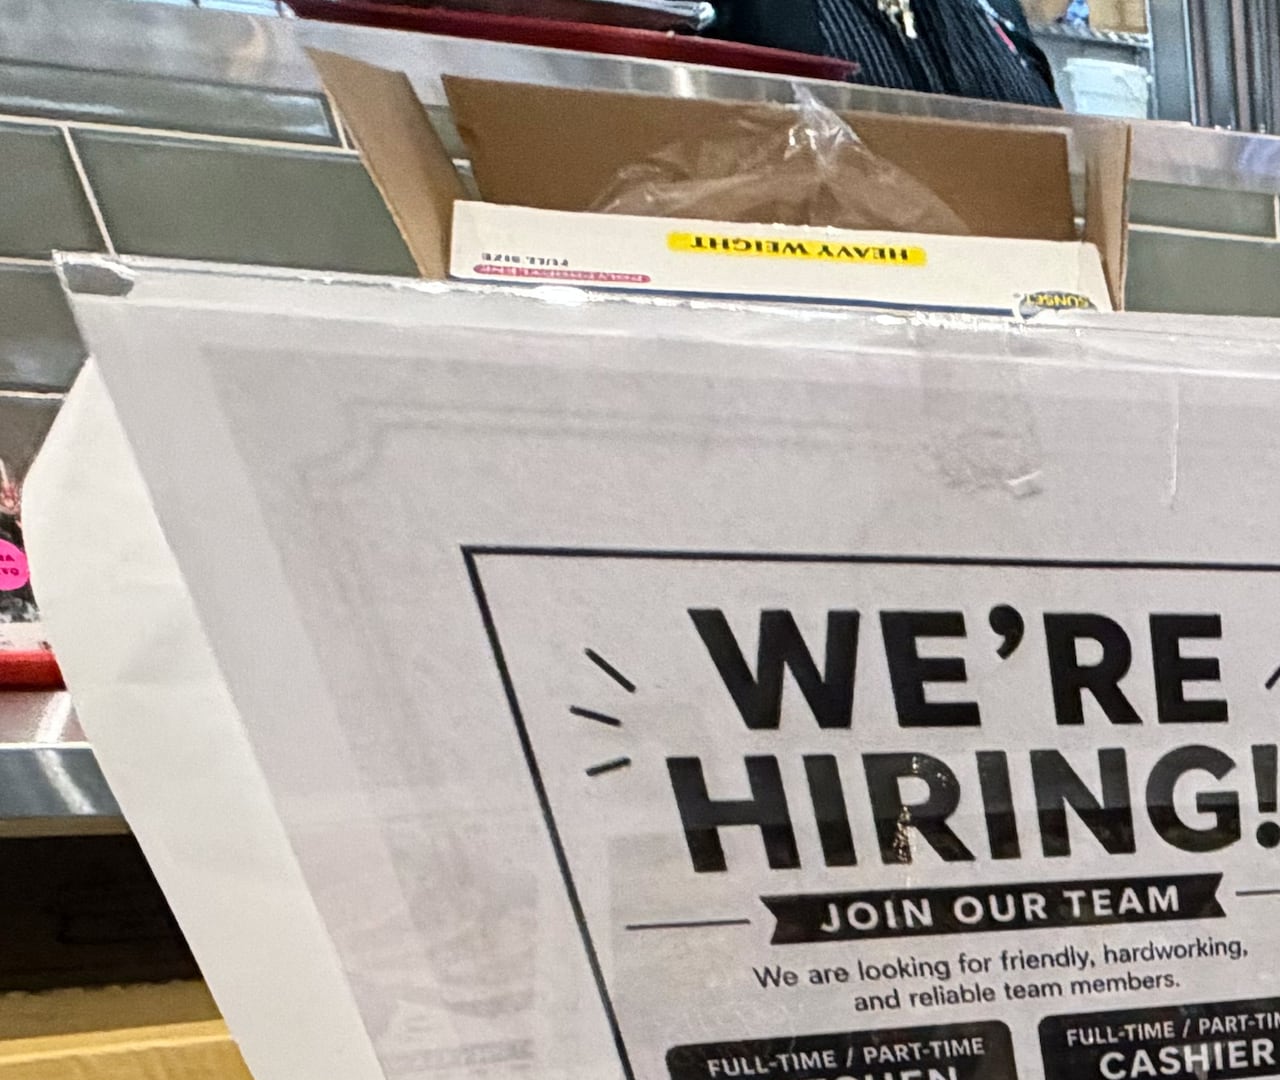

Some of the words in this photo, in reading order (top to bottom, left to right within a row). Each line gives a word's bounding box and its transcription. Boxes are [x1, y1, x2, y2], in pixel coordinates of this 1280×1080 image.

[689, 234, 809, 256] WEIGHT
[821, 243, 910, 263] HEAVY
[818, 895, 937, 936] JOIN
[951, 888, 1048, 927] OUR
[1063, 882, 1182, 921] TEAM
[752, 964, 800, 991] We
[808, 965, 850, 986] are
[856, 953, 952, 990] looking
[956, 950, 994, 976] for
[1000, 942, 1098, 977] friendly,
[1102, 935, 1250, 969] hardworking,
[853, 986, 901, 1014] and
[909, 982, 998, 1010] reliable
[1002, 978, 1063, 999] team
[1068, 971, 1182, 996] members.
[1065, 1019, 1178, 1048] FULL-TIME
[1180, 1018, 1193, 1041] /
[706, 1047, 836, 1080] FULL-TIME
[844, 1046, 855, 1069] /
[862, 1036, 986, 1067] PART-TIME
